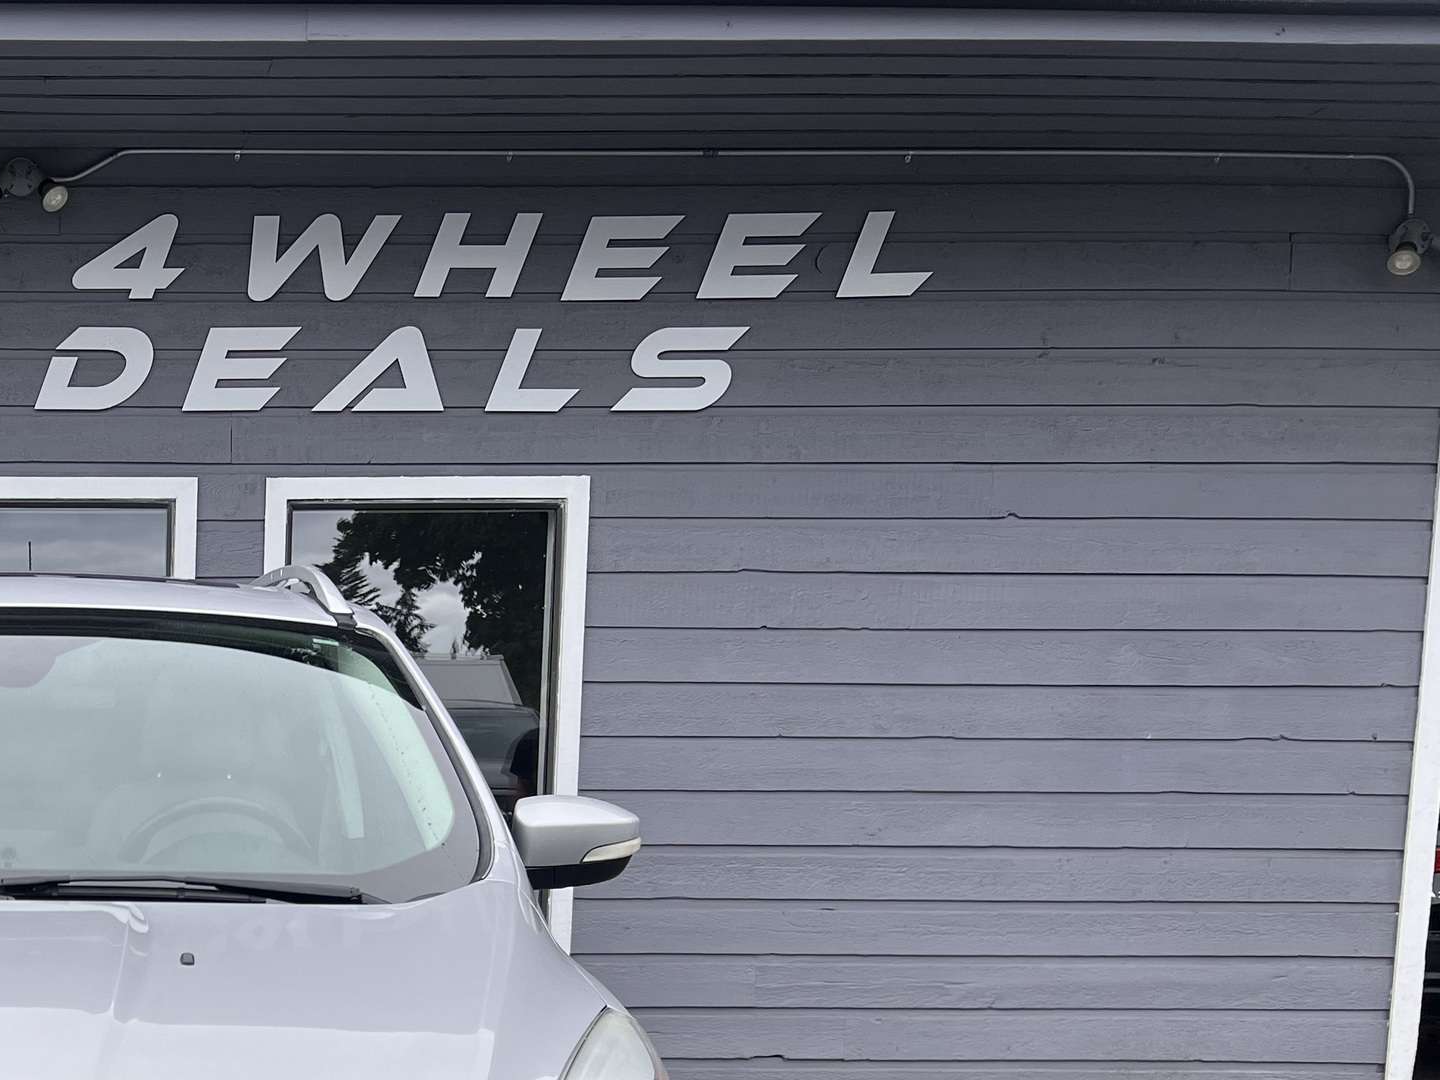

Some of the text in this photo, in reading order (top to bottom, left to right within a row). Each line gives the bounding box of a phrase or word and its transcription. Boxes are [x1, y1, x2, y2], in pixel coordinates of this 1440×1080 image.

[71, 210, 935, 302] 4 WHEEL
[33, 325, 752, 412] DEALS
